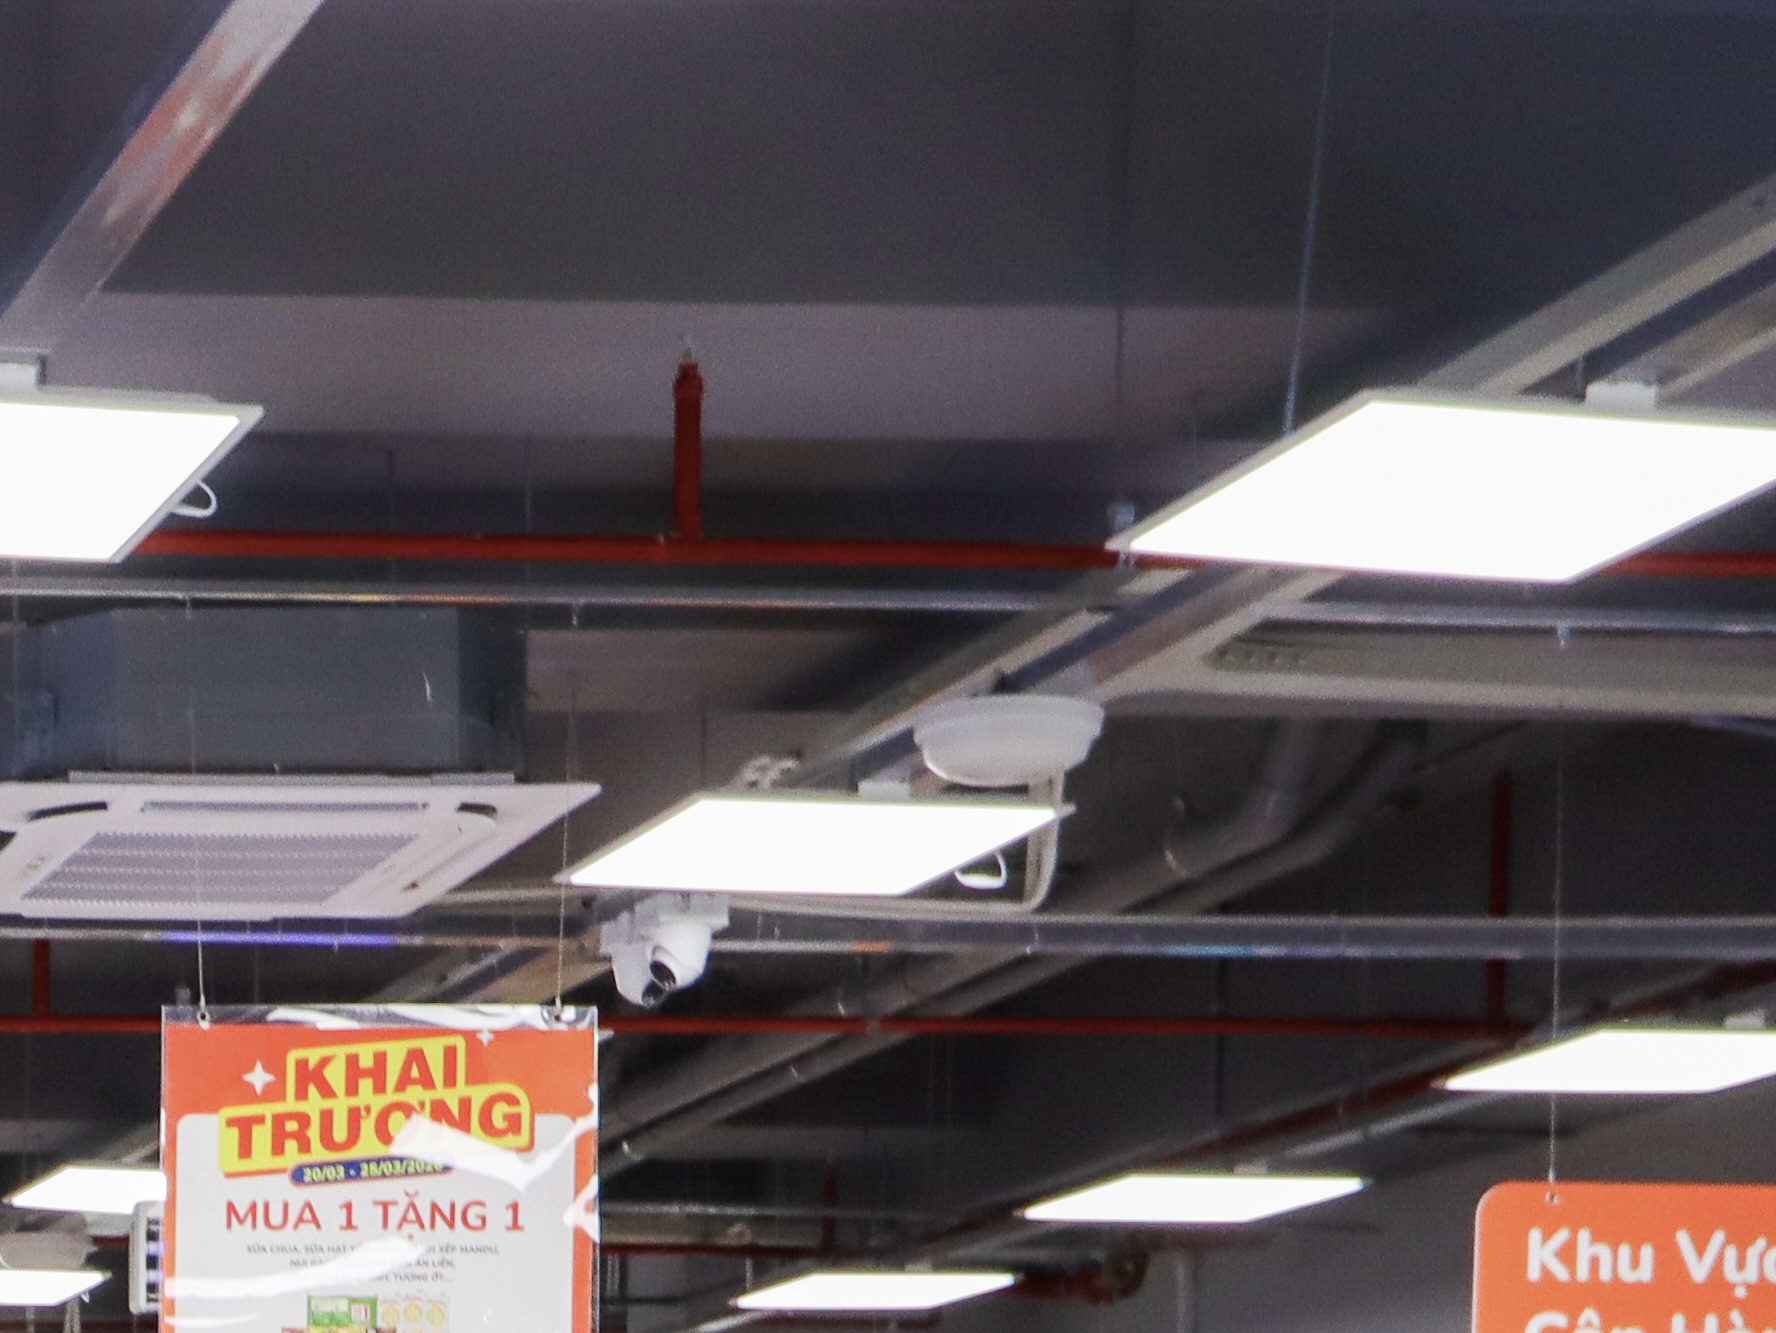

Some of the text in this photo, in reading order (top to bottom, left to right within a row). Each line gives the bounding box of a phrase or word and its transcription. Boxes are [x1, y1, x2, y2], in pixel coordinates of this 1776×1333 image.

[294, 1046, 459, 1102] KHAI
[225, 1092, 524, 1161] TRƯƠNG
[226, 1190, 525, 1241] MUA 1 TẶNG 1
[1527, 1227, 1655, 1284] Khu
